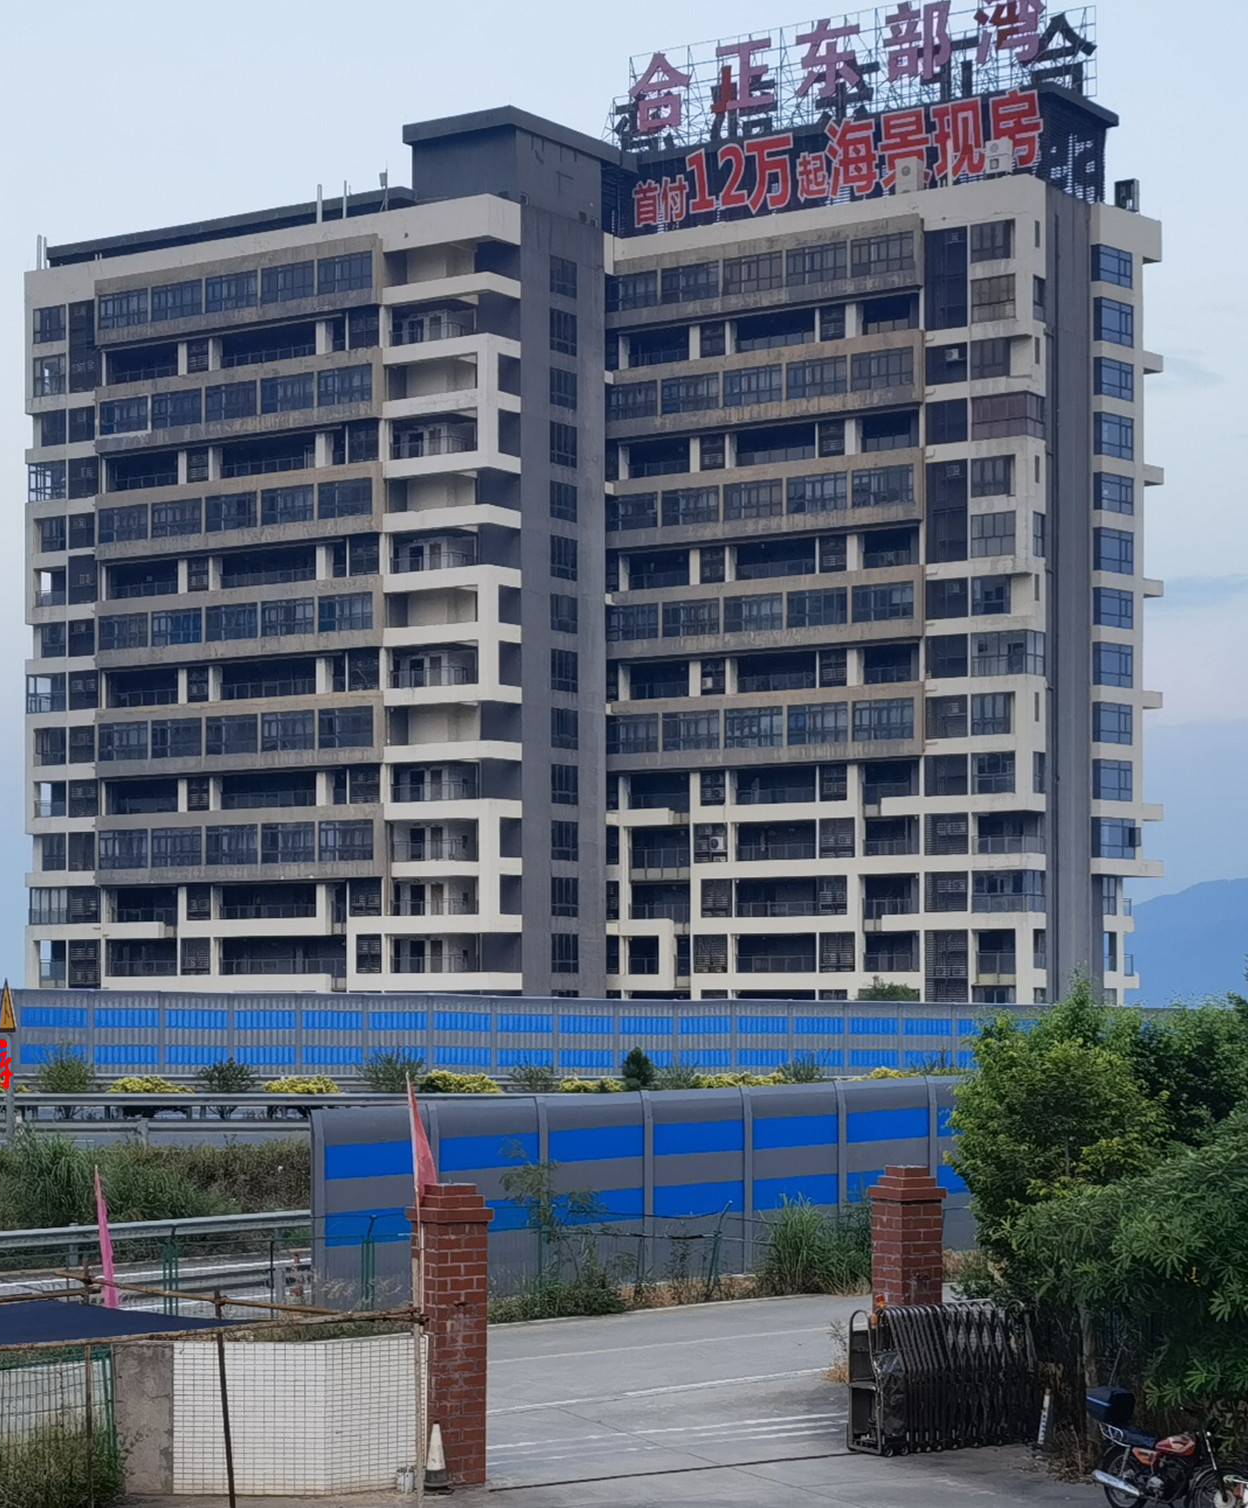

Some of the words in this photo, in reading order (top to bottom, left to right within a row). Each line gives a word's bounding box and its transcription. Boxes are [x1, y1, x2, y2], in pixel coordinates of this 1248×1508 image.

[628, 0, 1046, 133] 合正东部湾
[632, 88, 1044, 228] 首付12万起海景现房
